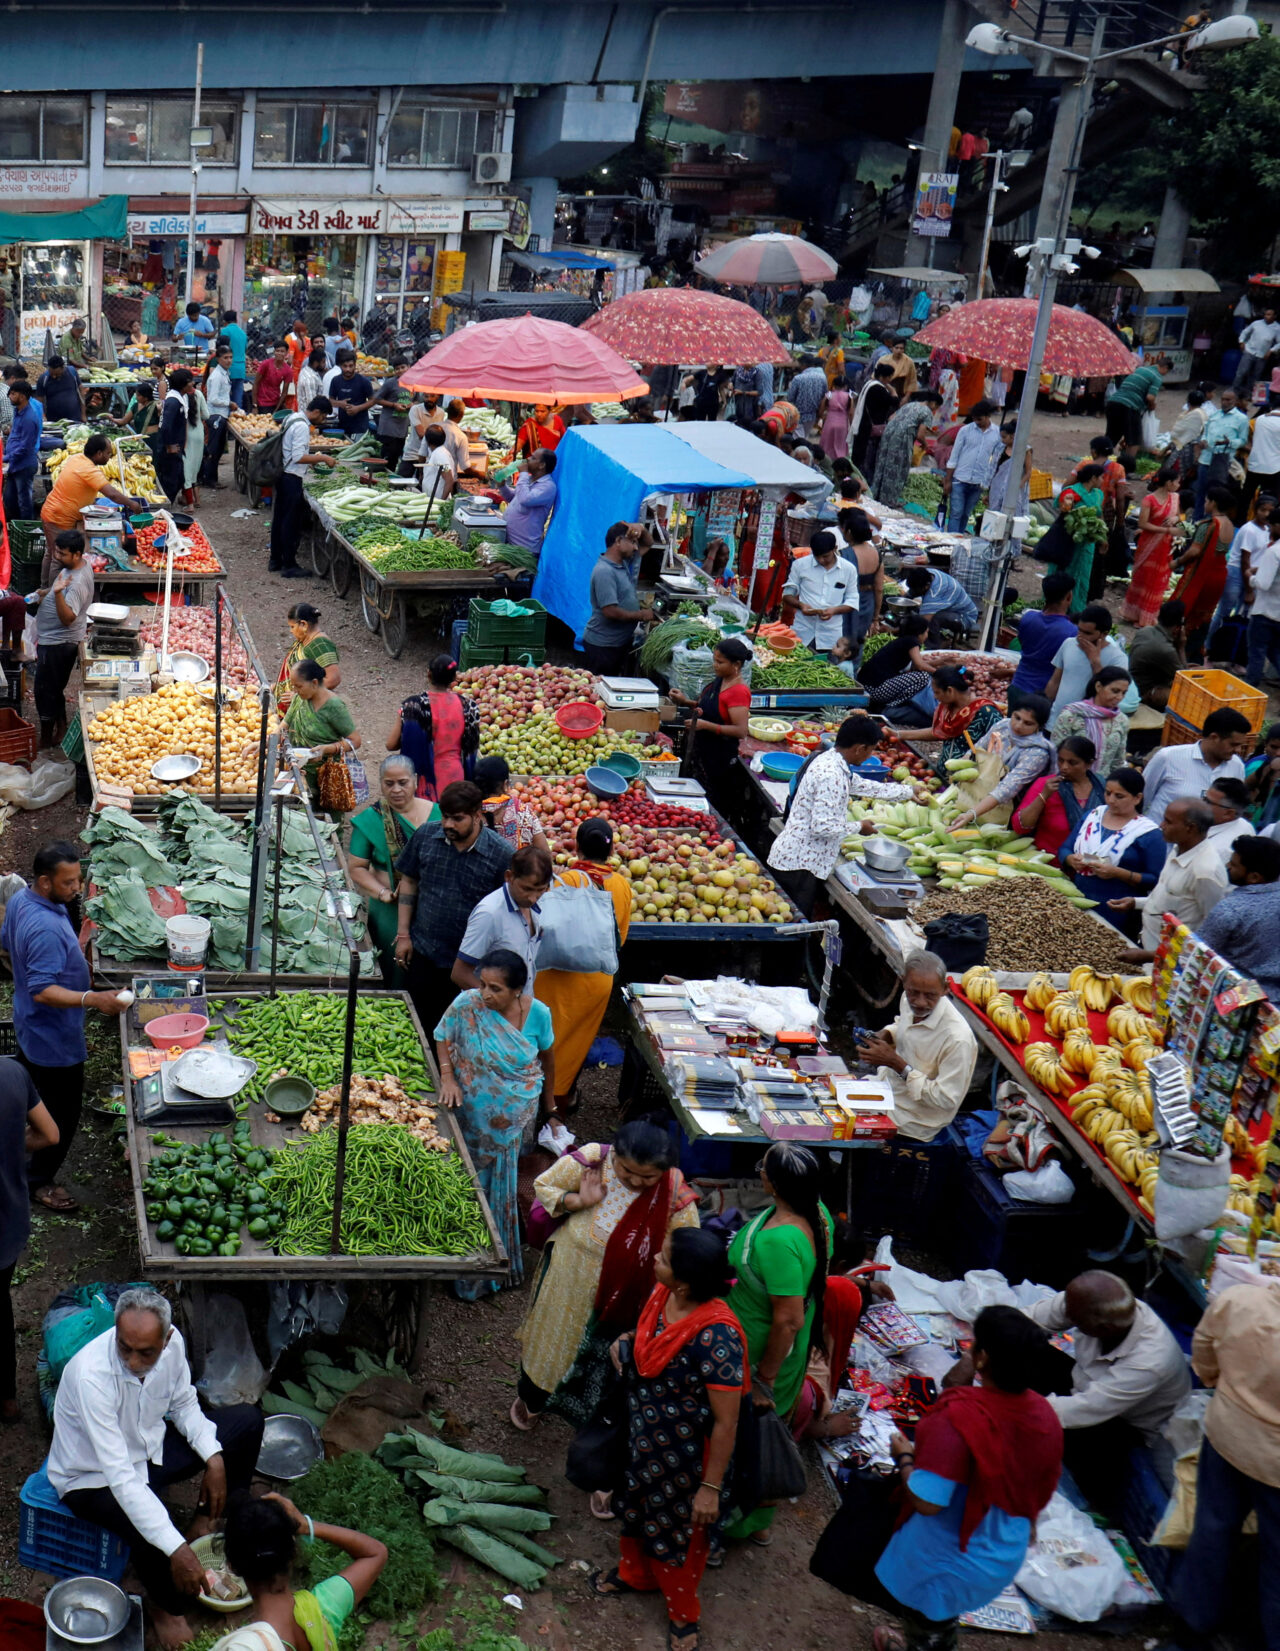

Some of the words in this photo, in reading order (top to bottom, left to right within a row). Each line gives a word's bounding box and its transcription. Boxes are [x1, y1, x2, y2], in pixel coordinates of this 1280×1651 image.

[257, 209, 293, 230] વૈભવ
[297, 209, 320, 230] ડેરી
[323, 209, 354, 230] સ્વીટ
[357, 209, 382, 230] માર્ટ
